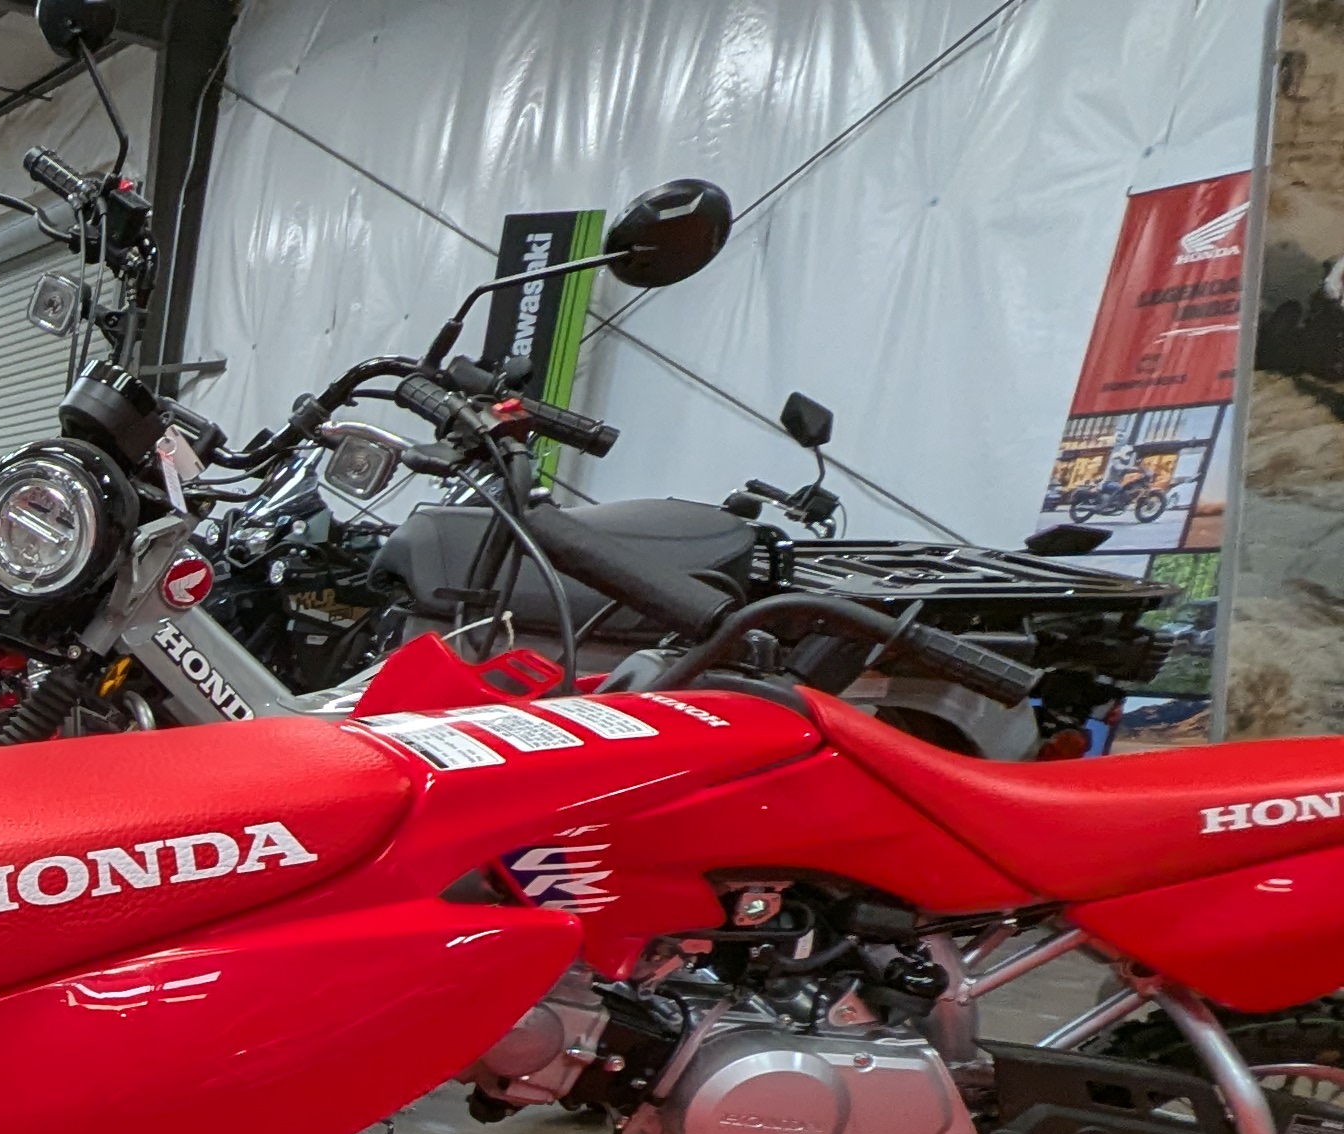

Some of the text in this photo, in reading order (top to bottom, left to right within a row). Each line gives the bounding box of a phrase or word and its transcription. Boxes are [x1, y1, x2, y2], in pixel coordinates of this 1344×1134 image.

[505, 232, 553, 364] awasaki
[154, 621, 255, 721] HOND
[1199, 791, 1344, 834] HON
